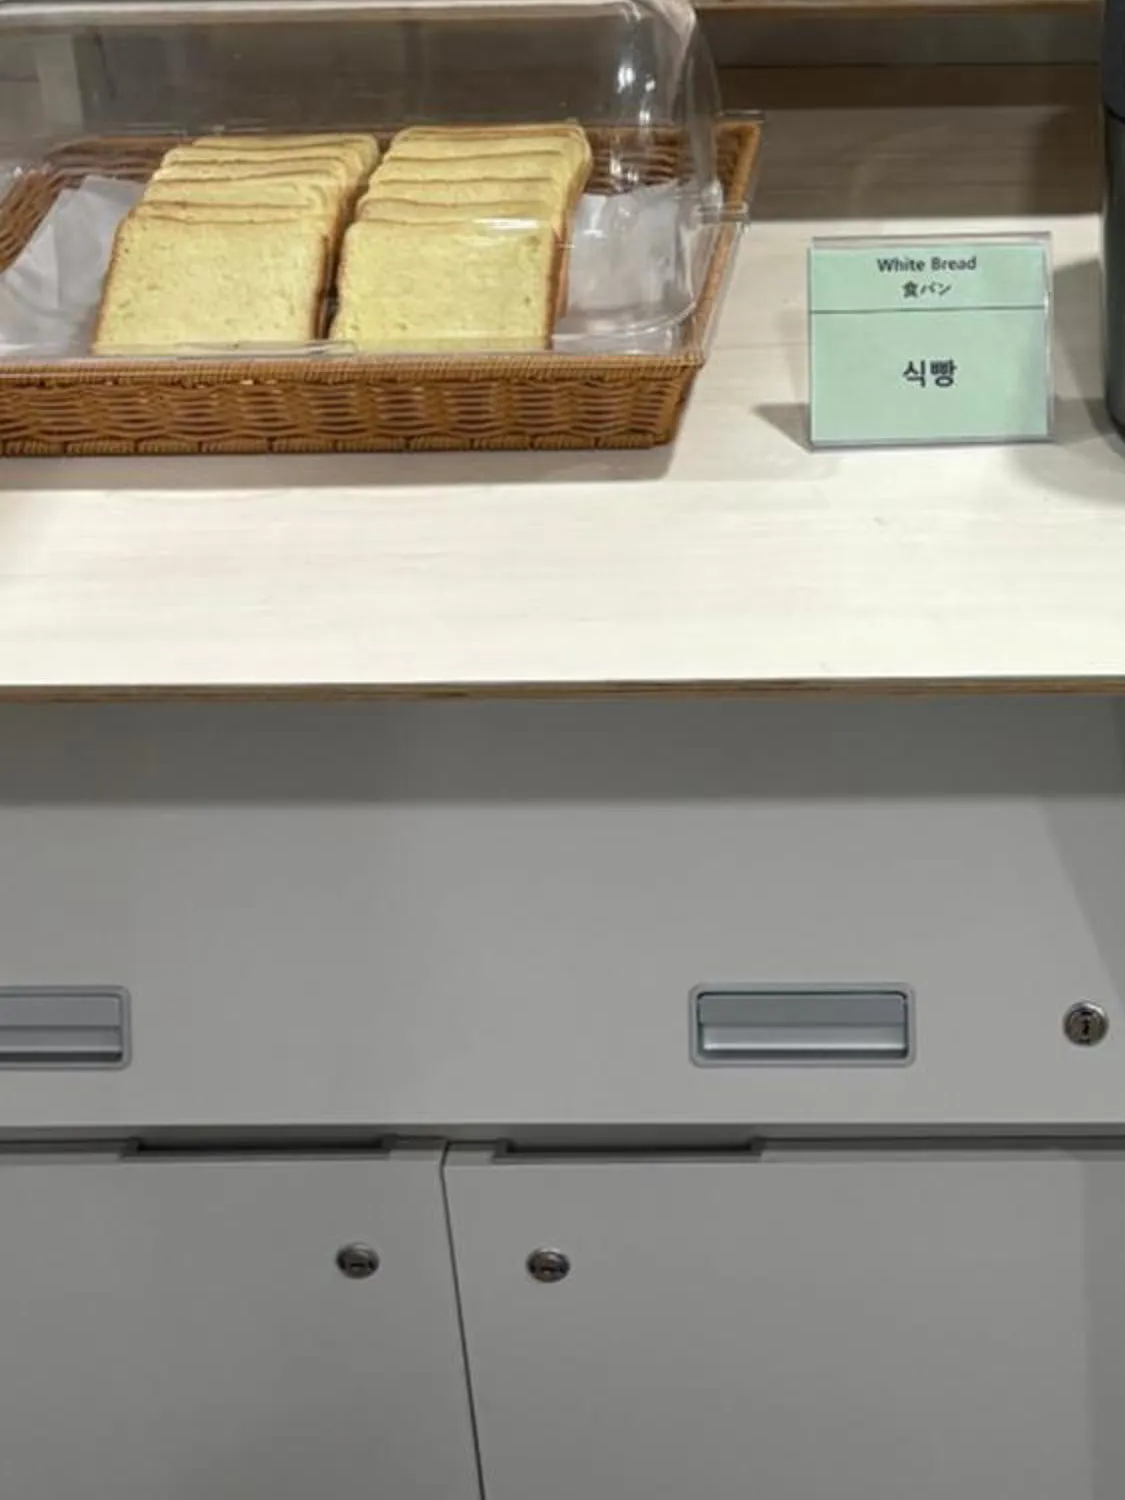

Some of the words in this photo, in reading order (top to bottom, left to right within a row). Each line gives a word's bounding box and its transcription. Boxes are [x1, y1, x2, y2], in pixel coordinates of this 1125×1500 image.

[877, 257, 926, 272] White
[931, 256, 978, 271] Bread
[903, 280, 952, 299] 食パン
[902, 359, 958, 388] 식빵
